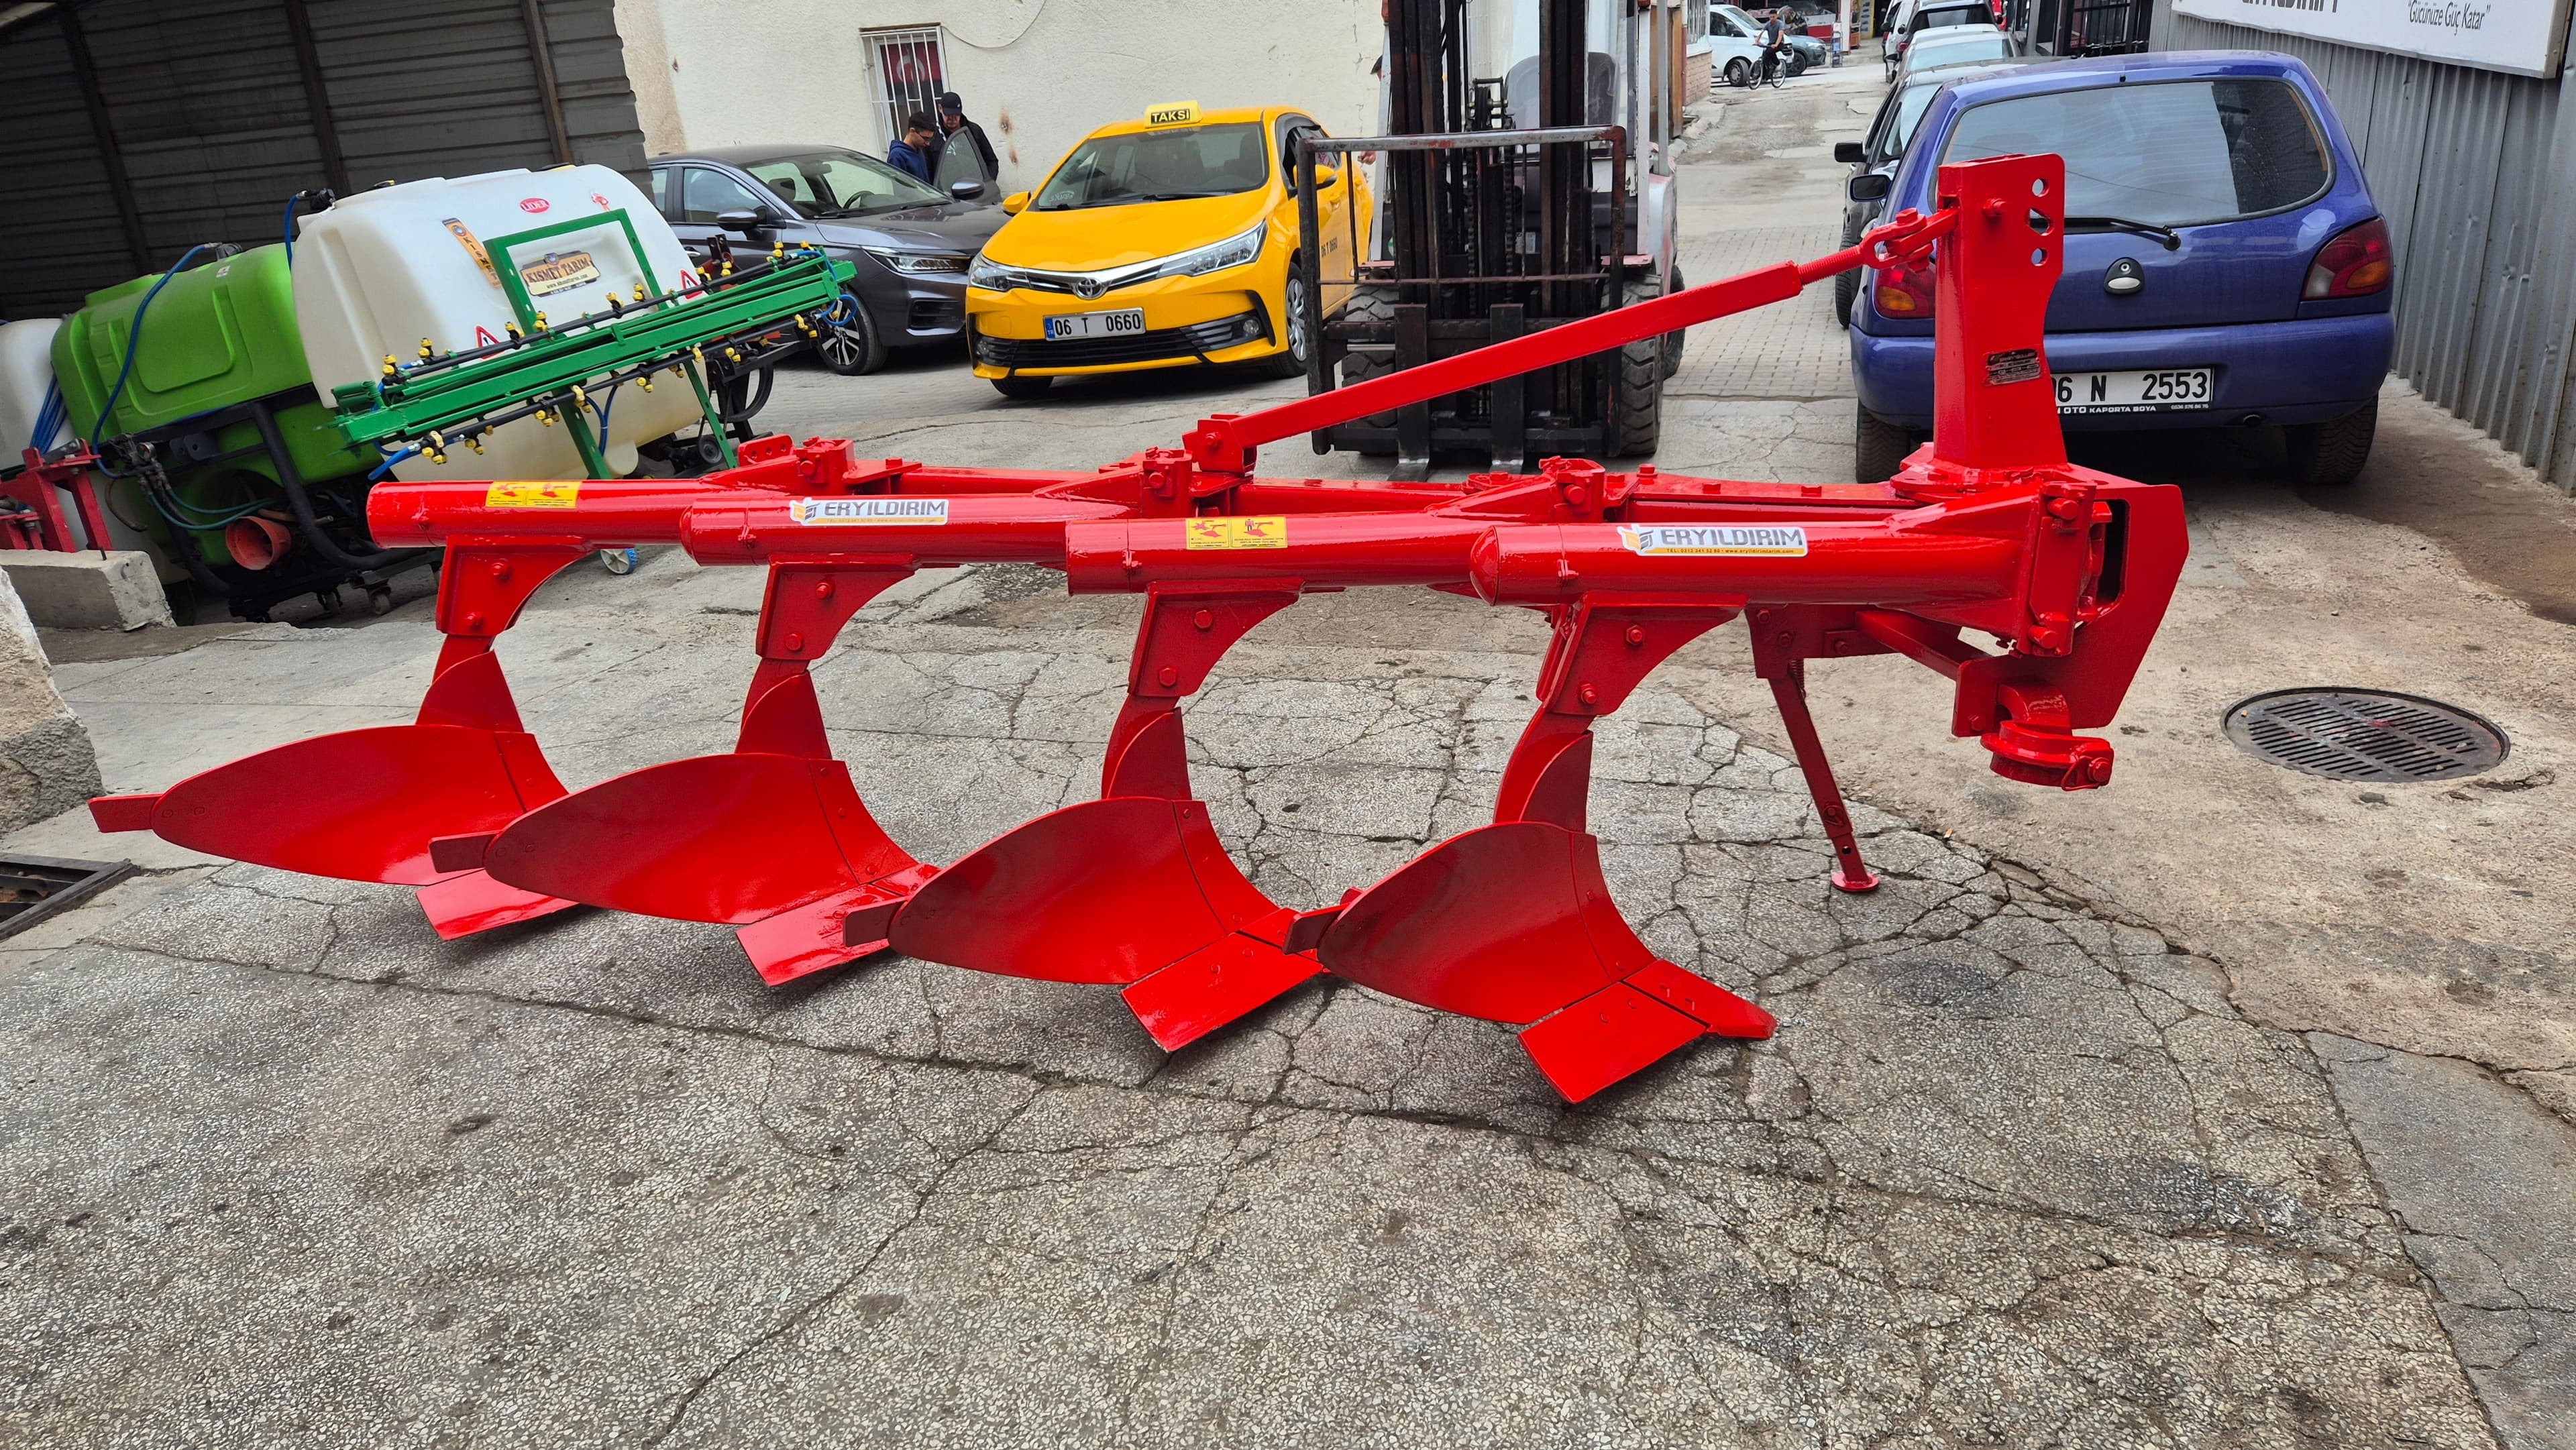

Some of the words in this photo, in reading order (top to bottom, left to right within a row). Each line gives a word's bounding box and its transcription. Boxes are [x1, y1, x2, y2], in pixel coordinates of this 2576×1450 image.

[2445, 1, 2461, 36] Güç
[526, 266, 564, 283] KISMET
[1055, 319, 1072, 335] 06
[1081, 317, 1088, 333] T
[1106, 313, 1140, 331] 0660
[2091, 376, 2106, 402] N
[2141, 372, 2208, 400] 2553
[824, 501, 945, 516] ERYILDIRIM
[1660, 528, 1803, 546] ERYILDIRIM
